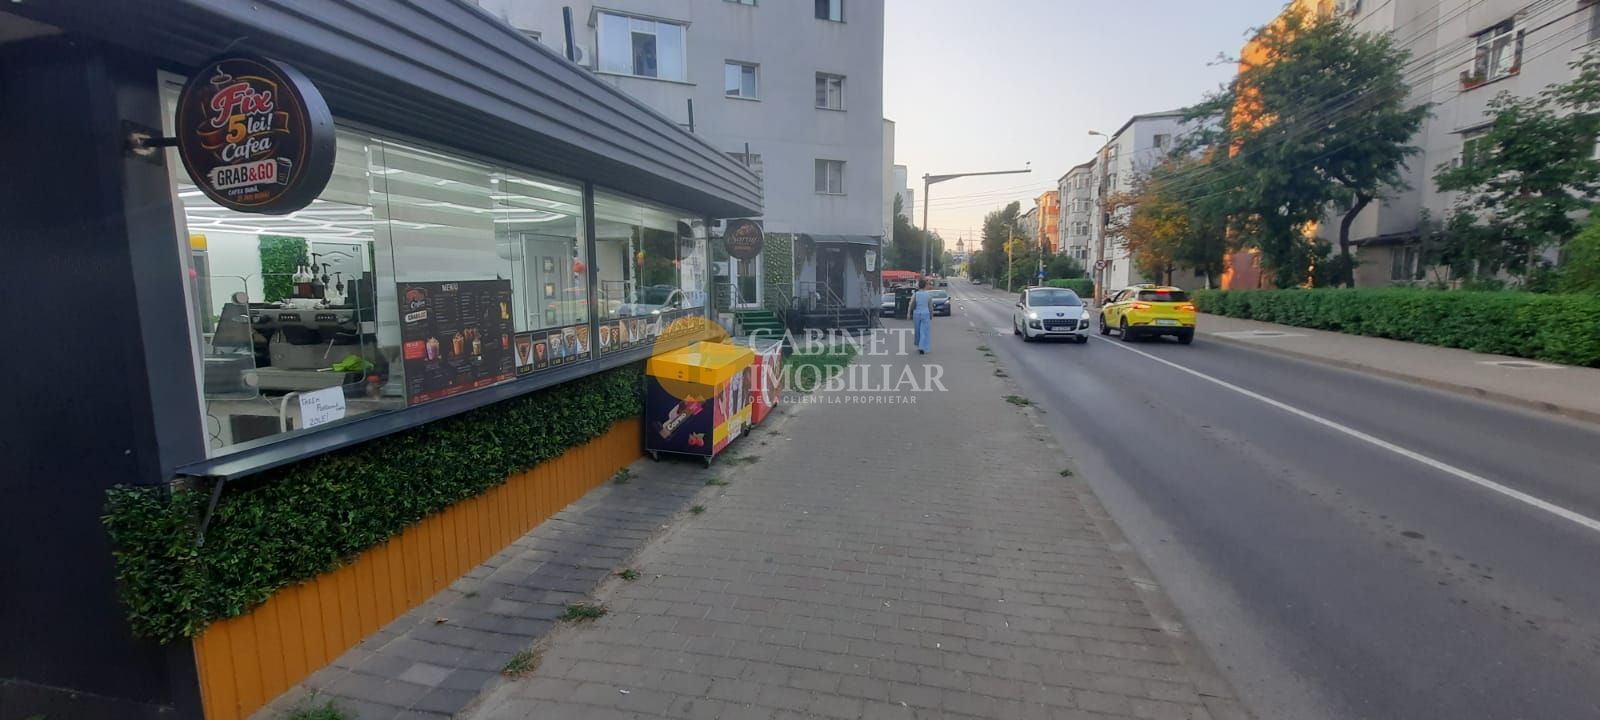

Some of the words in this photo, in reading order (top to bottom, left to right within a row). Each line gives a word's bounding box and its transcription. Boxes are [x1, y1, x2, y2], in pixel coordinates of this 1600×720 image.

[211, 82, 273, 128] Fix
[225, 114, 247, 143] 5
[247, 114, 273, 134] lei!
[222, 135, 272, 162] Cafea
[217, 162, 273, 187] GRAB&GO
